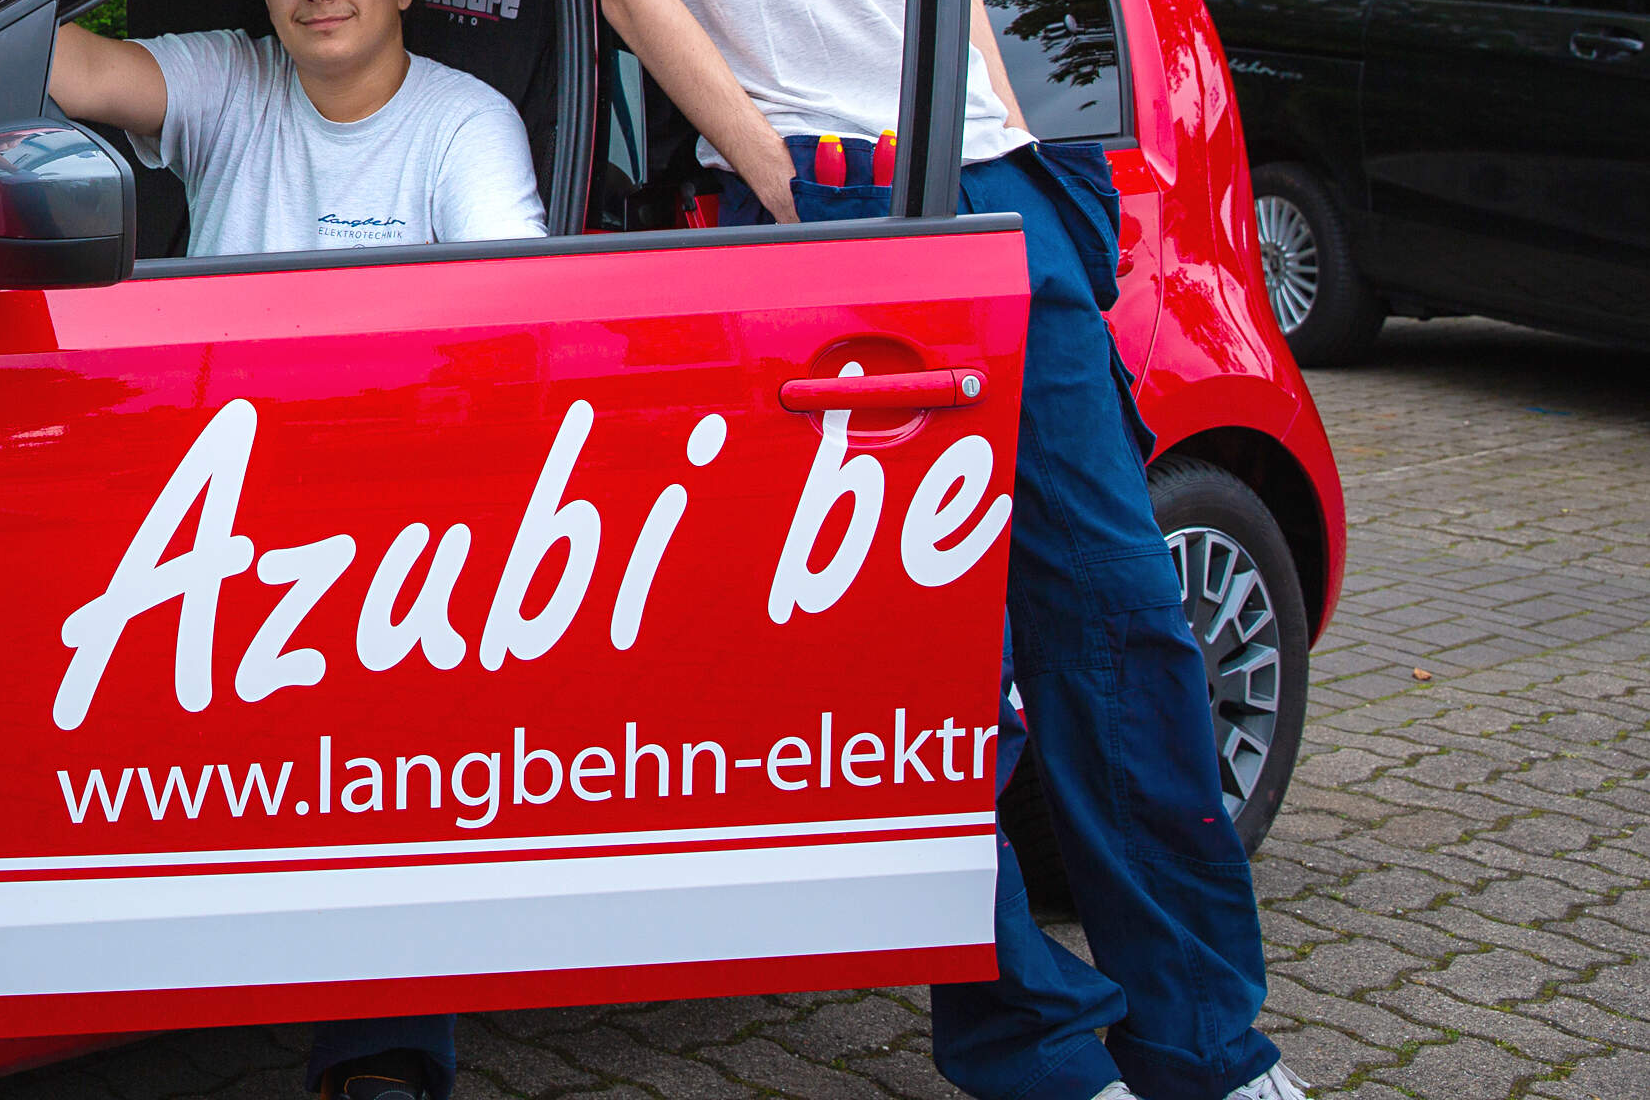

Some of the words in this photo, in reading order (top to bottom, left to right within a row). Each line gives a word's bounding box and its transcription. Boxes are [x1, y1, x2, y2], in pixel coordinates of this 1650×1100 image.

[449, 13, 478, 26] PRO
[317, 226, 403, 240] ELEKTROTECHNIK
[52, 398, 727, 731] Azubi
[767, 361, 1013, 625] be
[56, 707, 999, 829] www.langbehn-elektr
